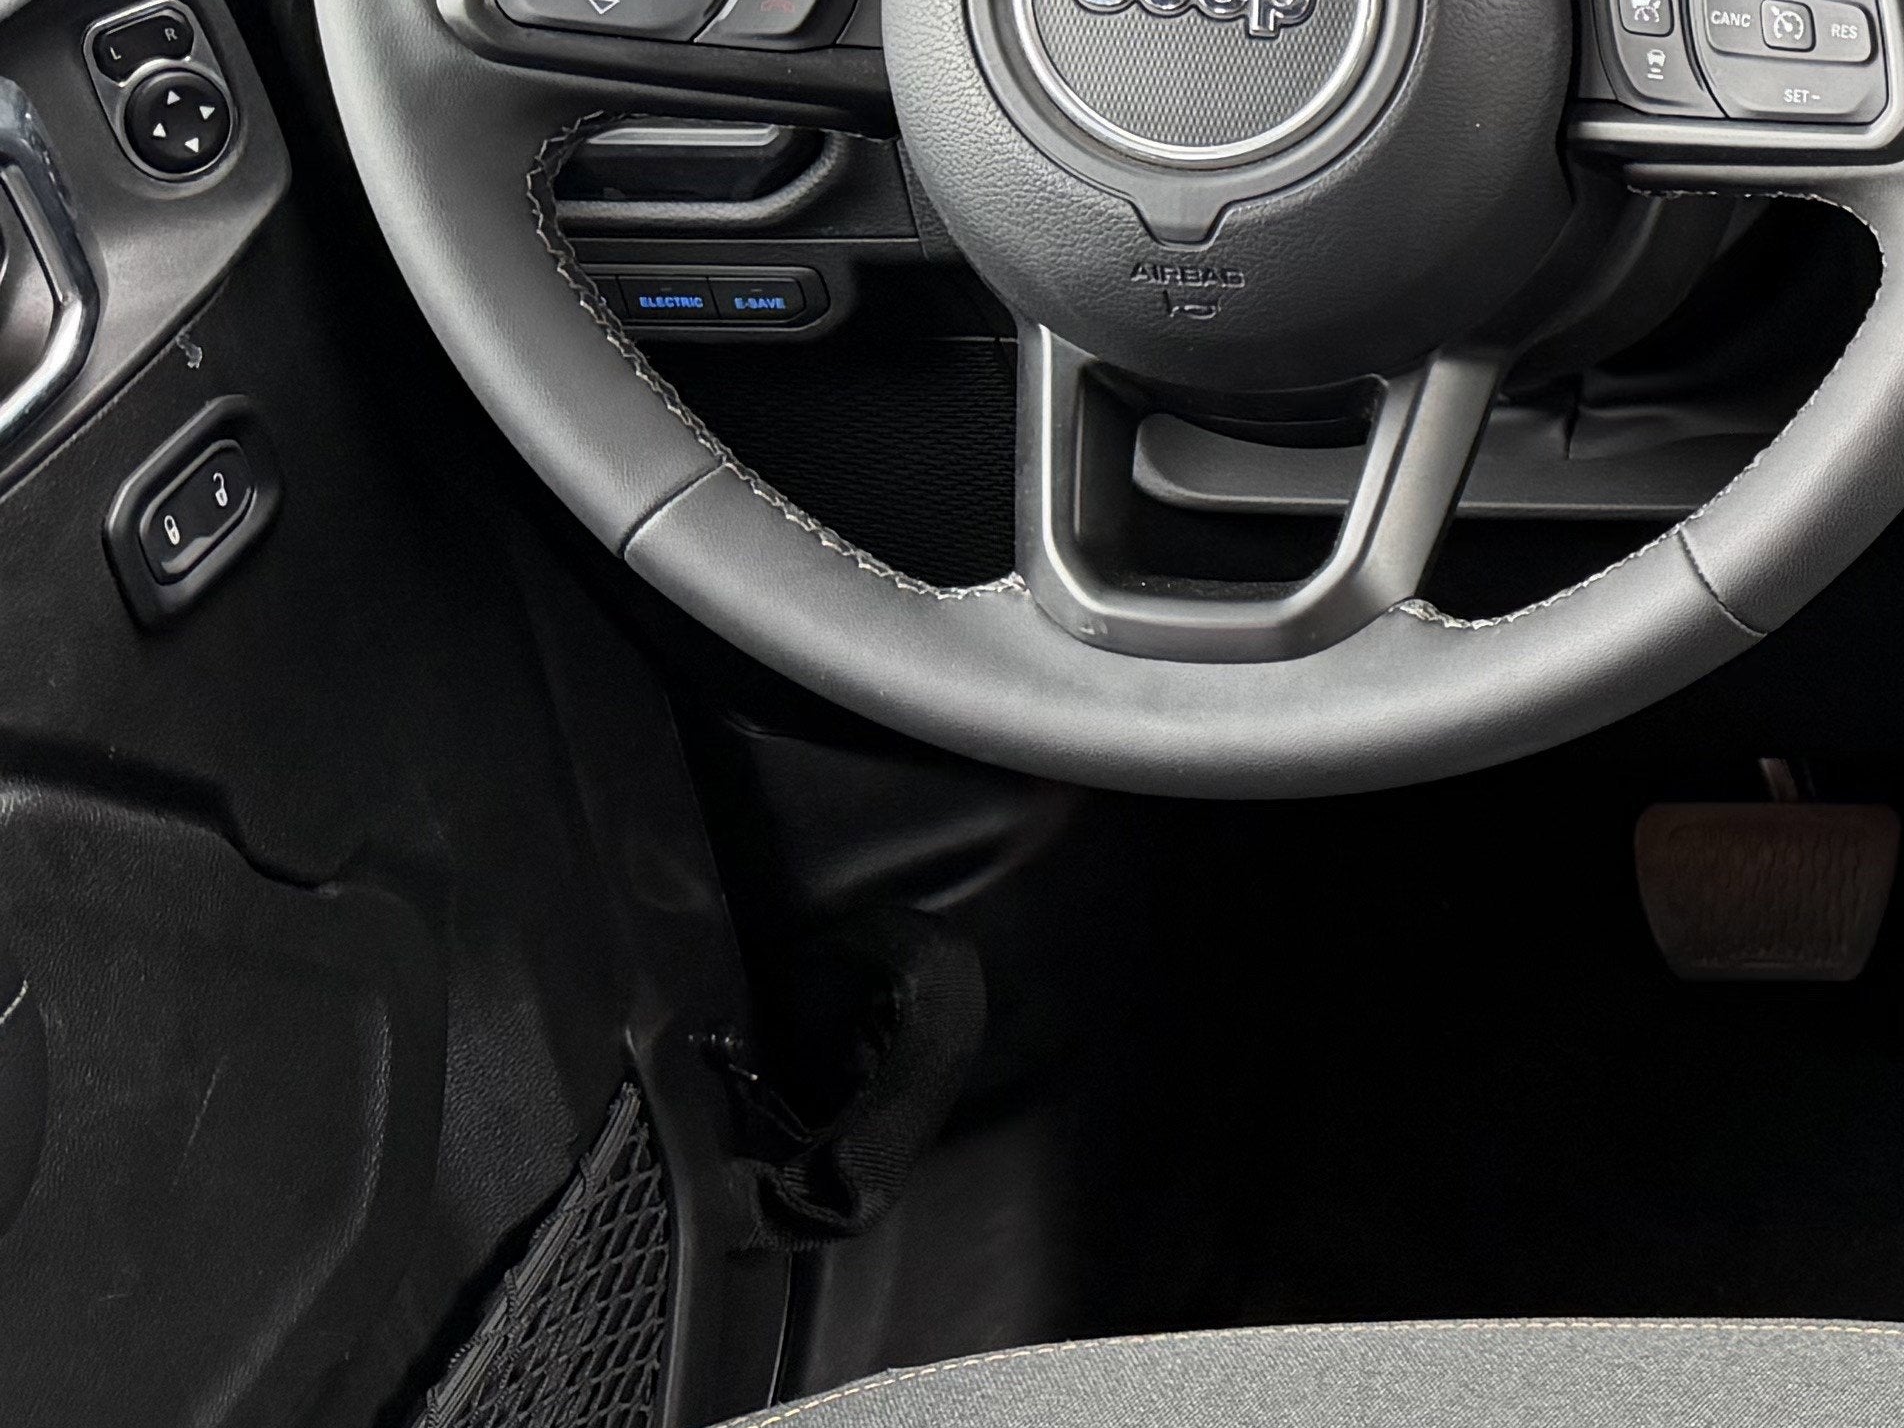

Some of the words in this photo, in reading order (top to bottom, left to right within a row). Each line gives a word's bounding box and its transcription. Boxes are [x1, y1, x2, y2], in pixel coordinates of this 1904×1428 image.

[1710, 9, 1752, 28] CANC
[164, 27, 178, 41] R
[1830, 23, 1858, 40] RES
[109, 46, 122, 61] L
[639, 296, 704, 309] ELECTRIC
[733, 296, 786, 310] E-SAVE
